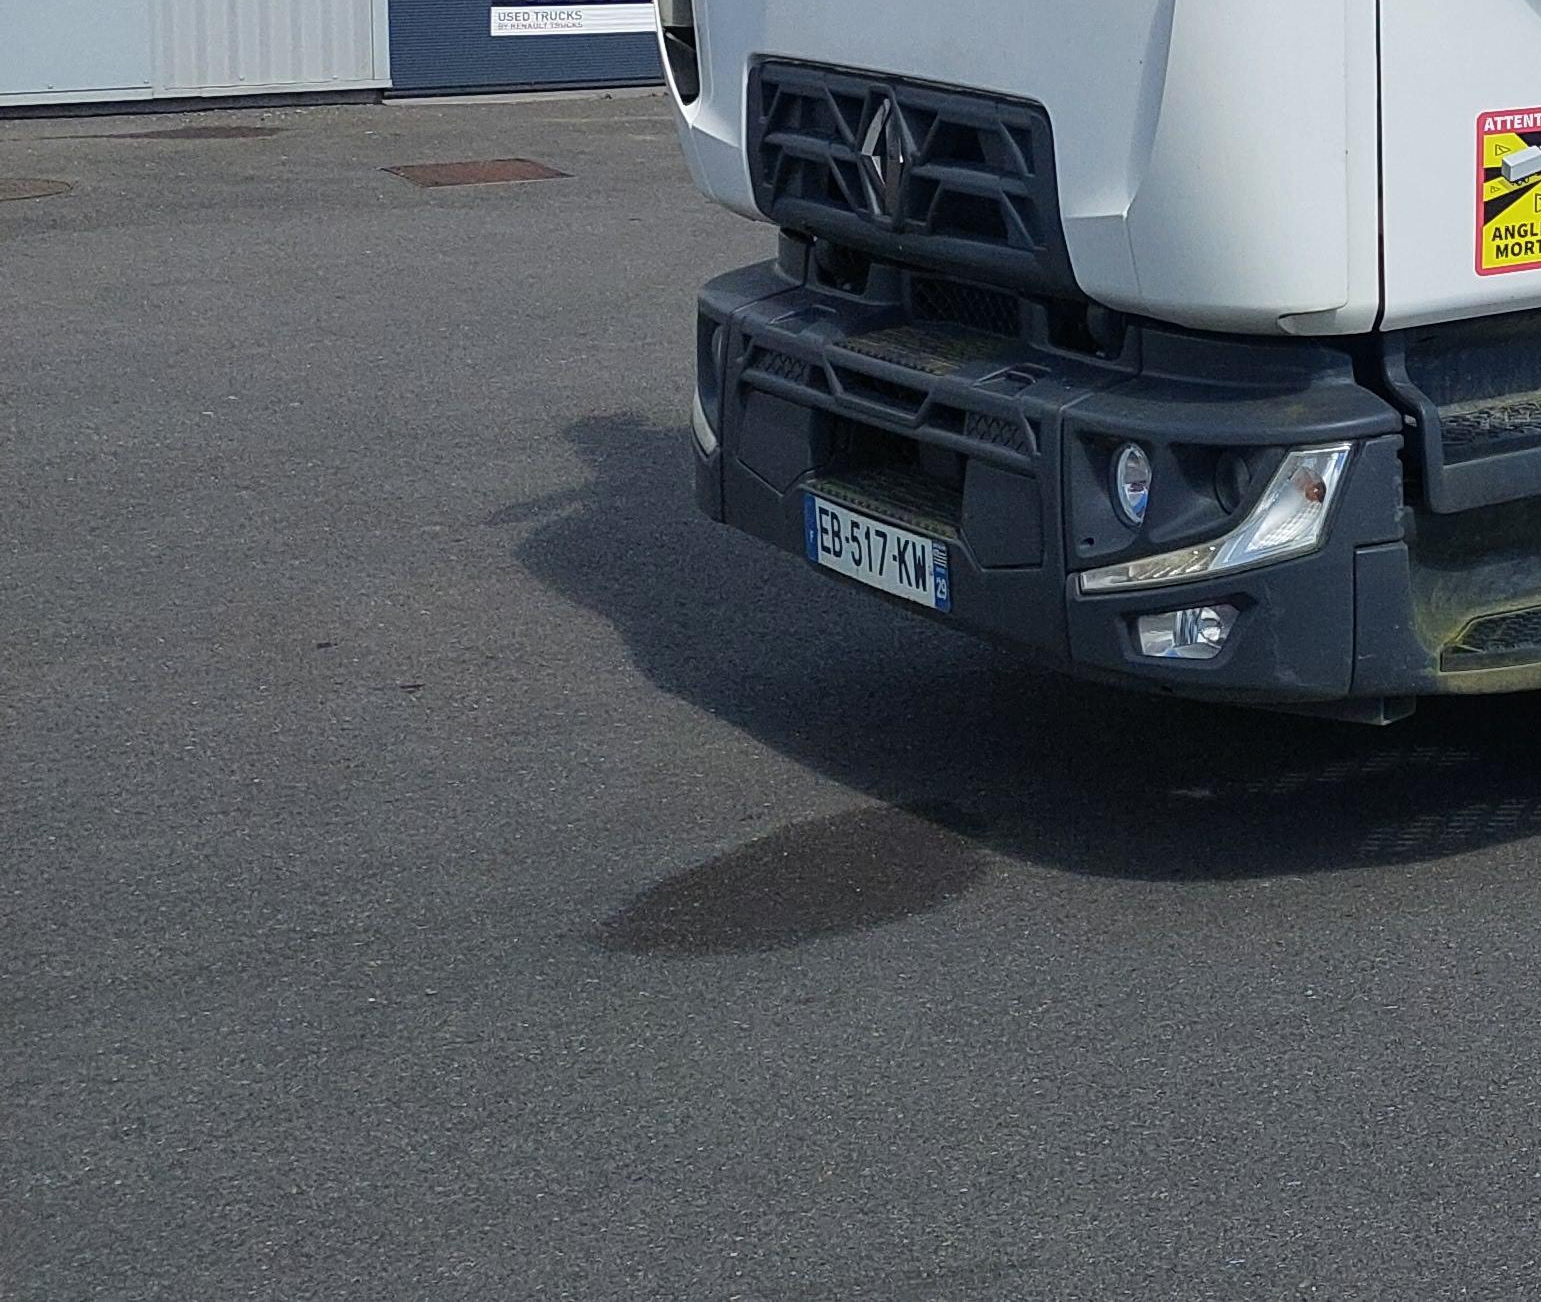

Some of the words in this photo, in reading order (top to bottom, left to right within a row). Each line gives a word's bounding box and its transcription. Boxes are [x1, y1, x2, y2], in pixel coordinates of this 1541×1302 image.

[498, 11, 530, 22] USED
[534, 10, 583, 22] TRUCKS
[818, 506, 928, 592] EB-517-KW
[936, 577, 947, 600] 29
